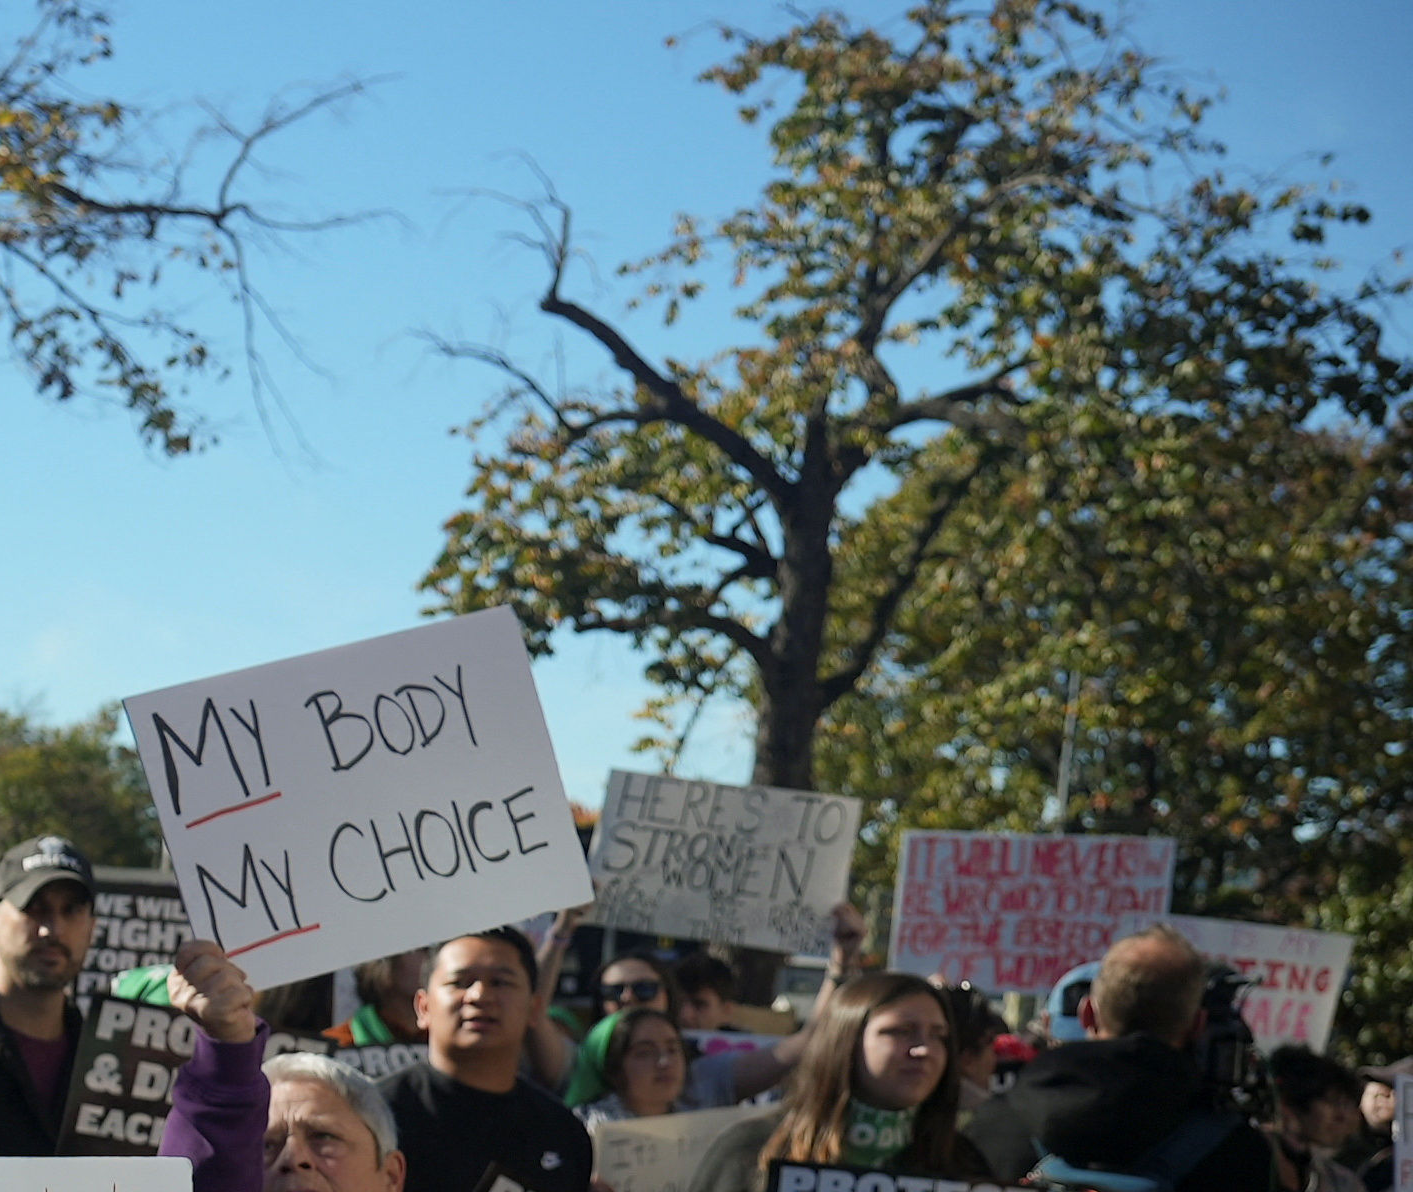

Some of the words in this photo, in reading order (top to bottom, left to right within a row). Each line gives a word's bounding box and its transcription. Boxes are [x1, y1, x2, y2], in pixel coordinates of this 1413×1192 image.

[151, 697, 273, 815] MY
[304, 664, 479, 773] BODY
[195, 842, 304, 952] MY
[328, 785, 549, 903] CHOICE
[792, 794, 848, 847] TO
[84, 1053, 123, 1096] &
